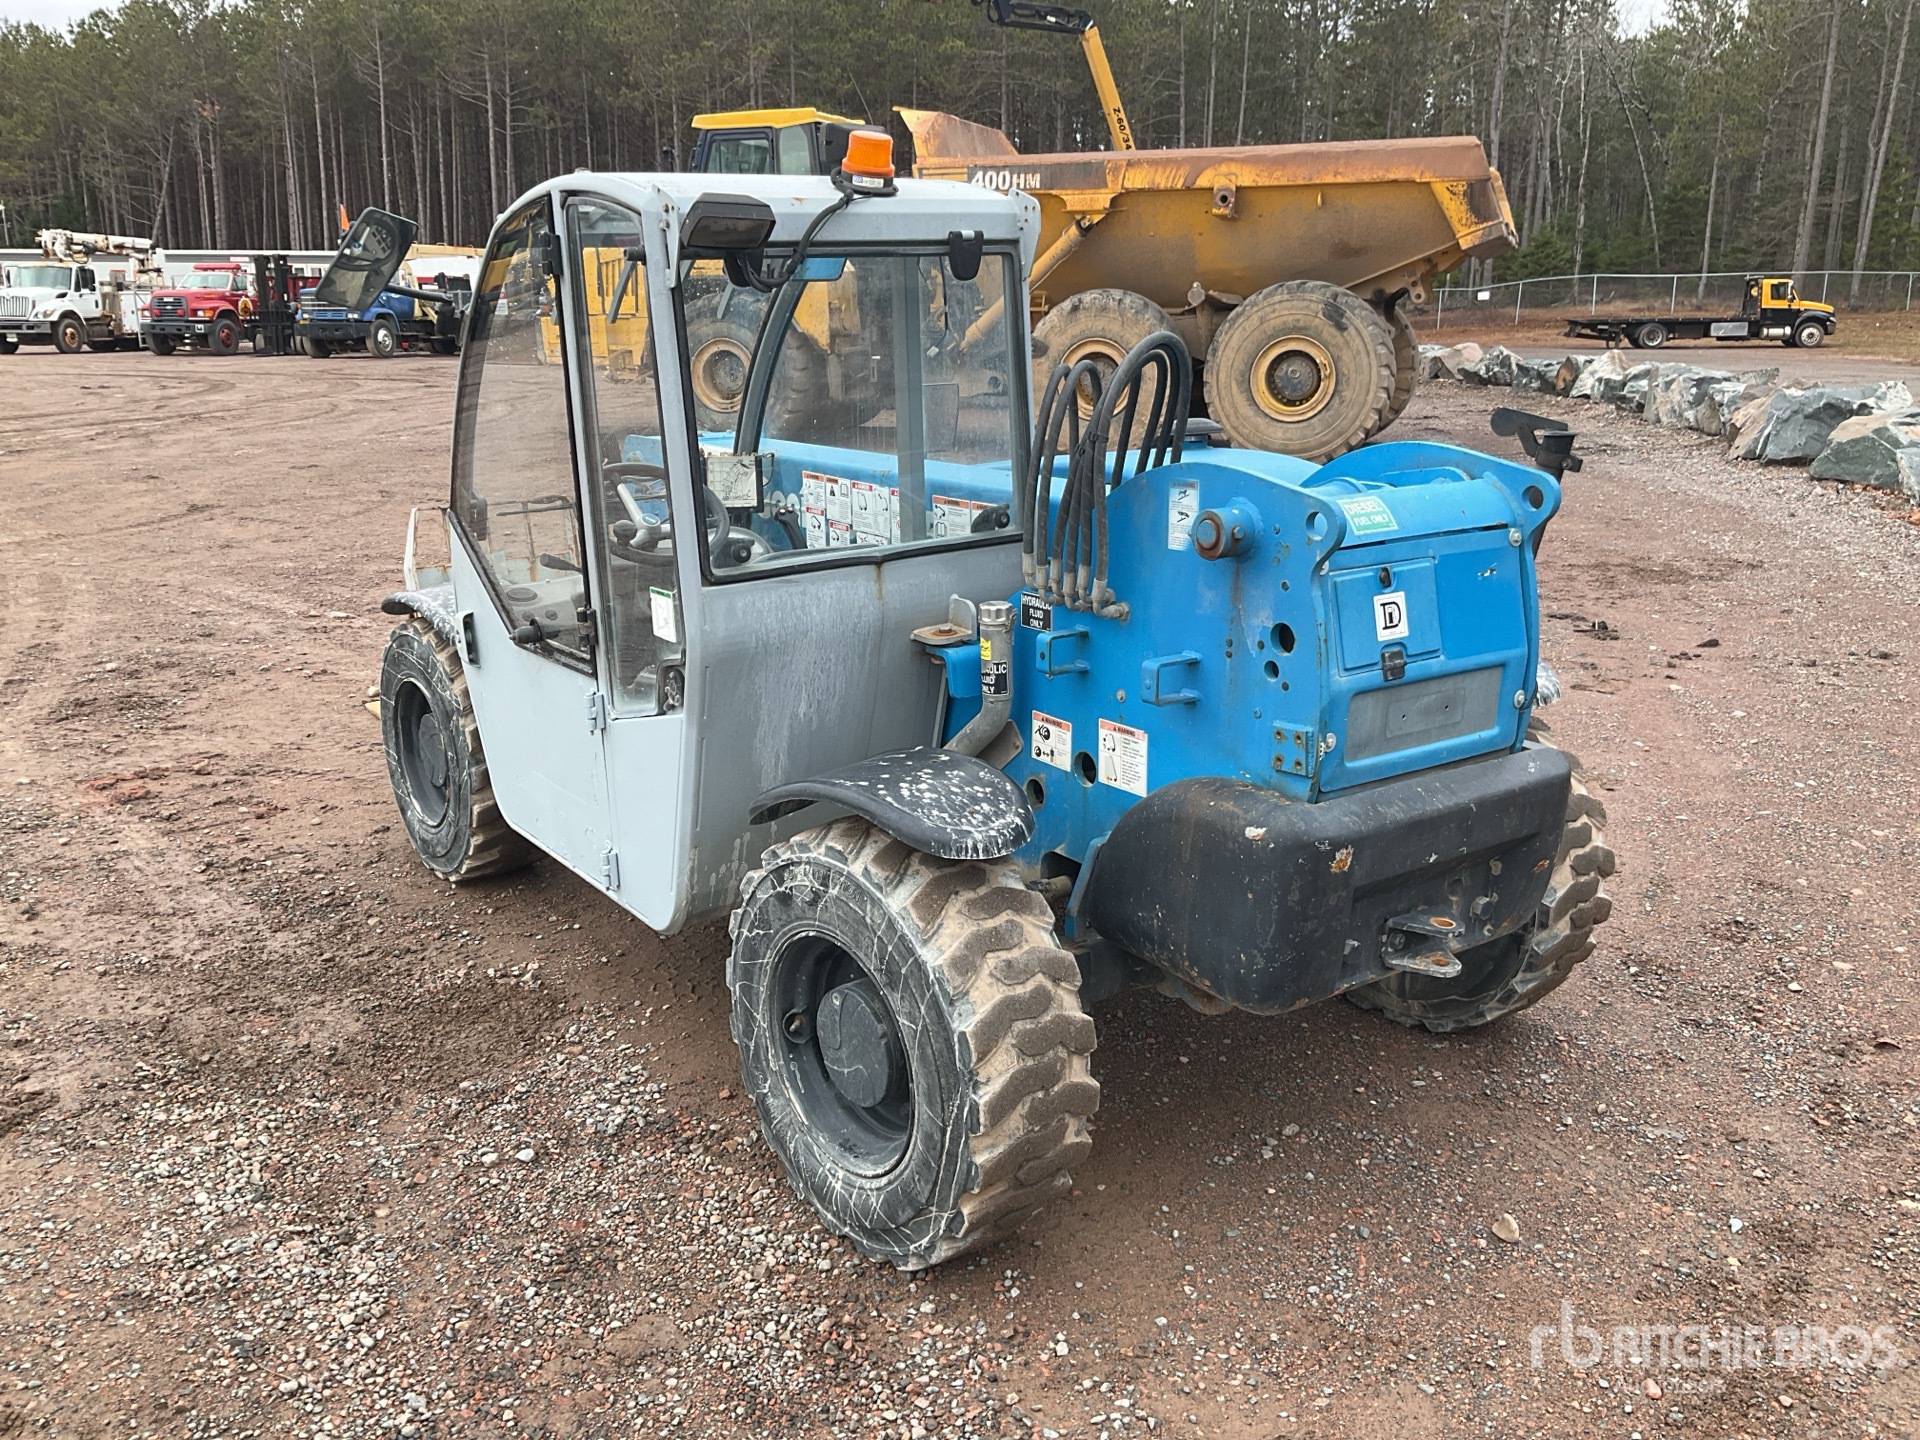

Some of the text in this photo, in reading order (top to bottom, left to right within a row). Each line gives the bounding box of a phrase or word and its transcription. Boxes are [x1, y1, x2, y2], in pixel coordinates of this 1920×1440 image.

[1112, 106, 1132, 150] Z-60/34
[1343, 501, 1384, 514] DIESEL
[1353, 514, 1389, 526] FUEL ONLY
[1029, 608, 1044, 619] FLUID
[1030, 618, 1044, 629] ONLY
